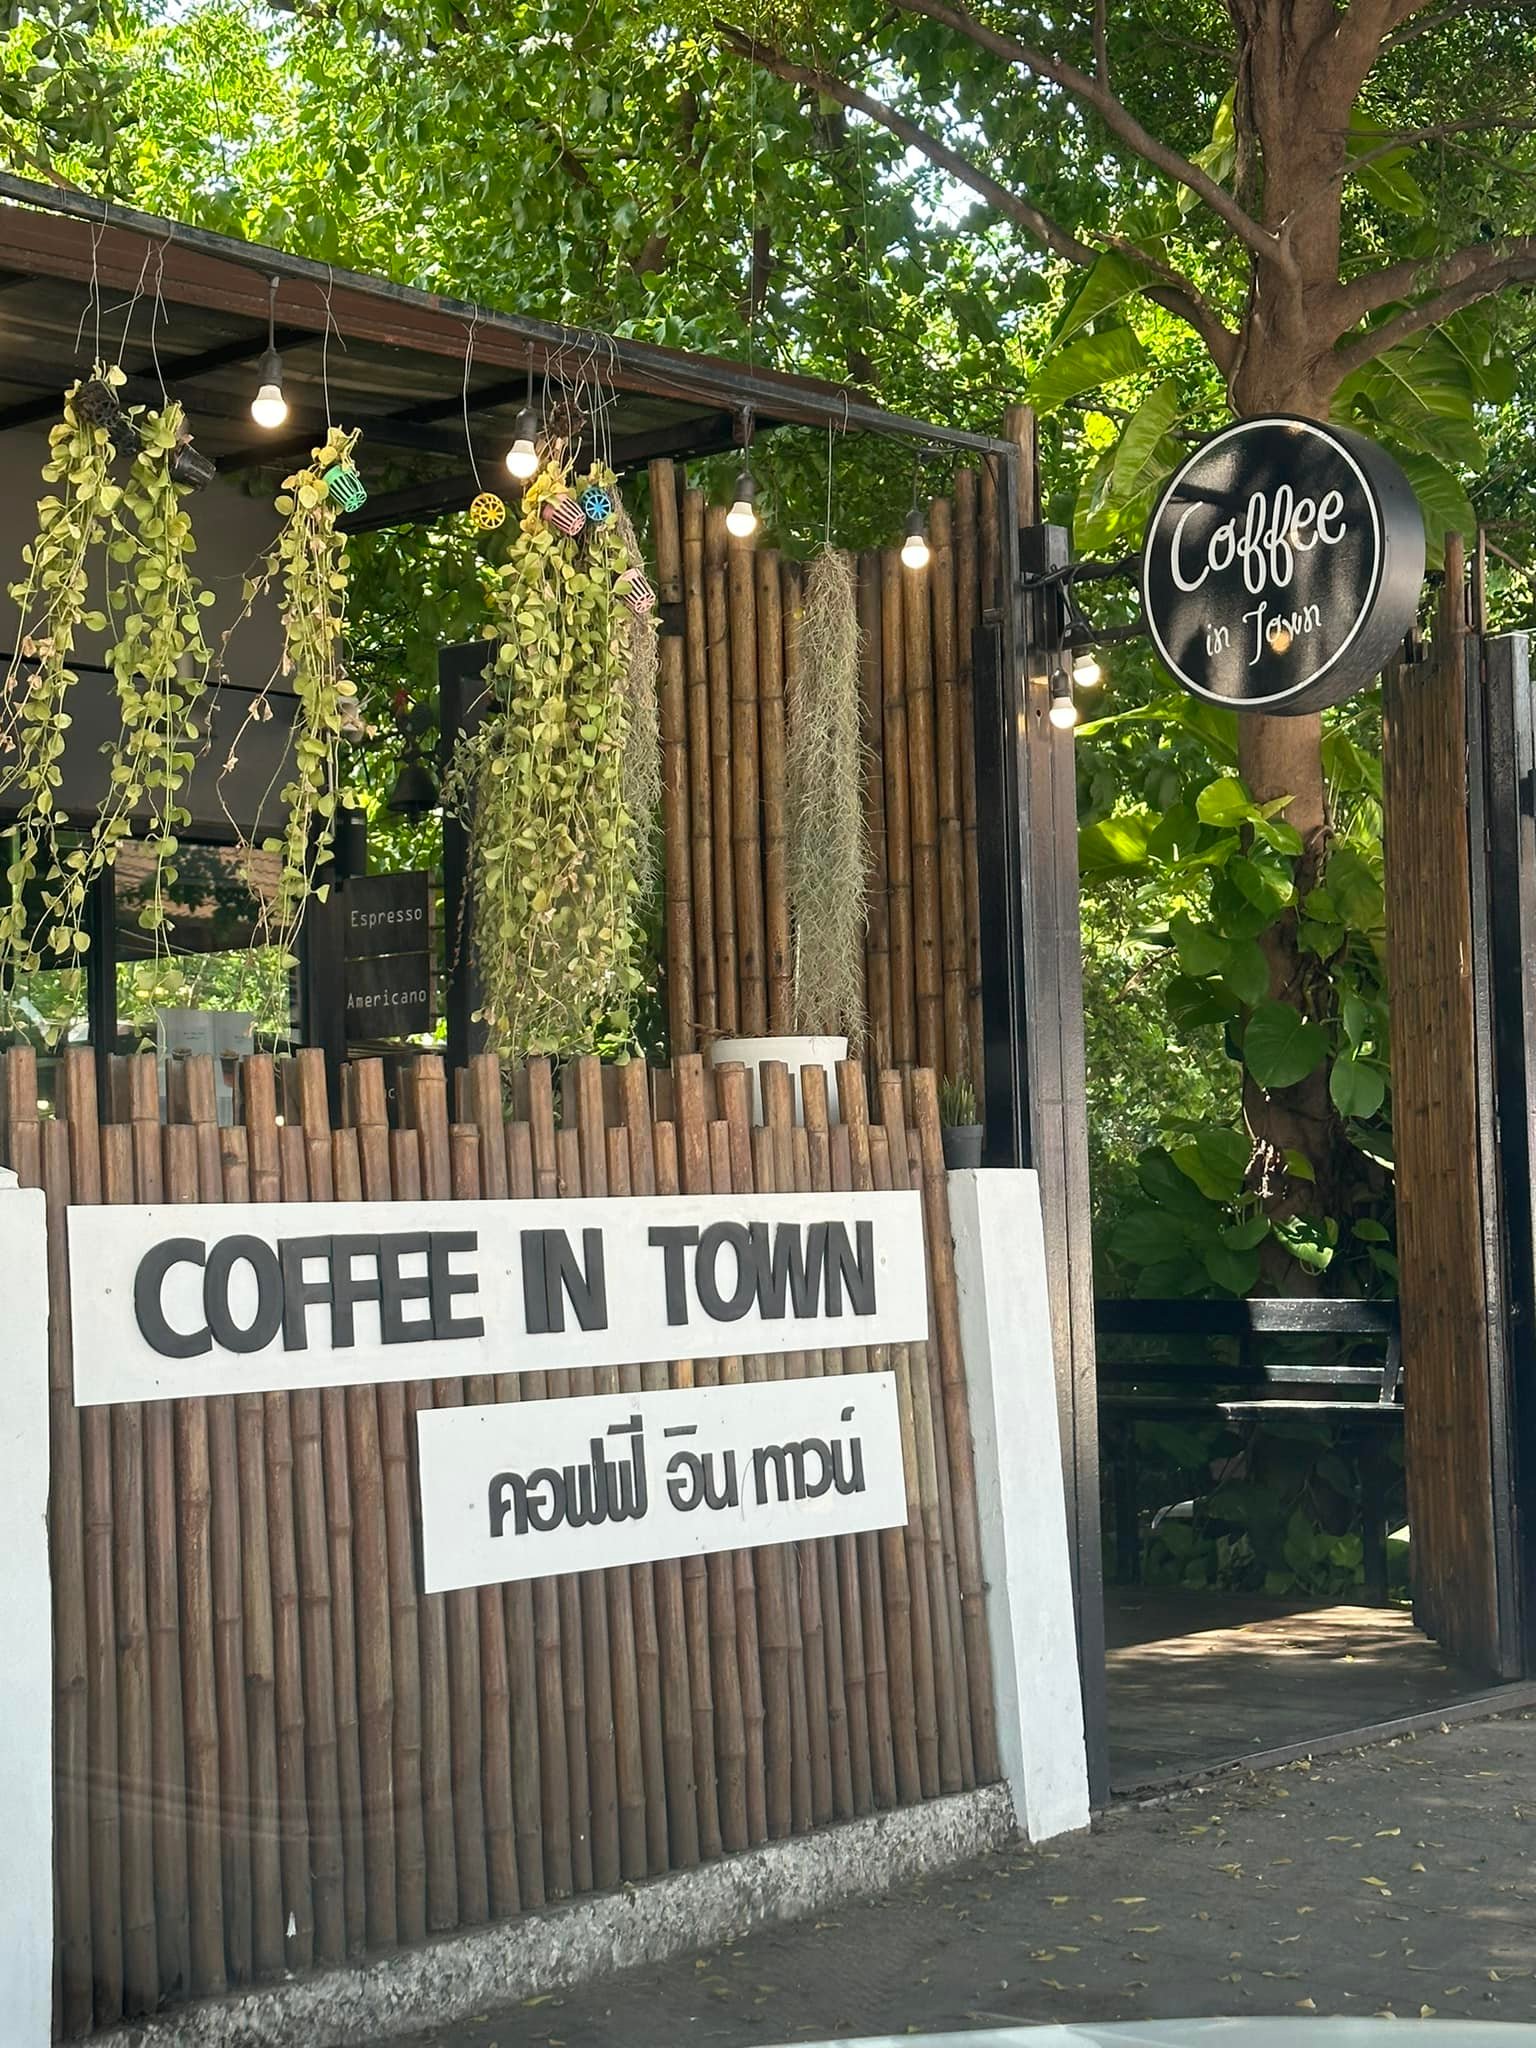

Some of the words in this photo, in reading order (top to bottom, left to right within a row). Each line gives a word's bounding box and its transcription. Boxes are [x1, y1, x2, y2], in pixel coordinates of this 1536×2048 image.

[1171, 484, 1347, 594] Coffee
[1206, 622, 1231, 657] in
[1242, 600, 1322, 667] Town
[350, 907, 424, 929] Espresso
[346, 989, 428, 1010] Americano
[133, 1230, 485, 1359] COFFEE
[520, 1228, 609, 1335] IN
[647, 1220, 877, 1327] TOWN
[752, 1406, 866, 1506] ทาวน์
